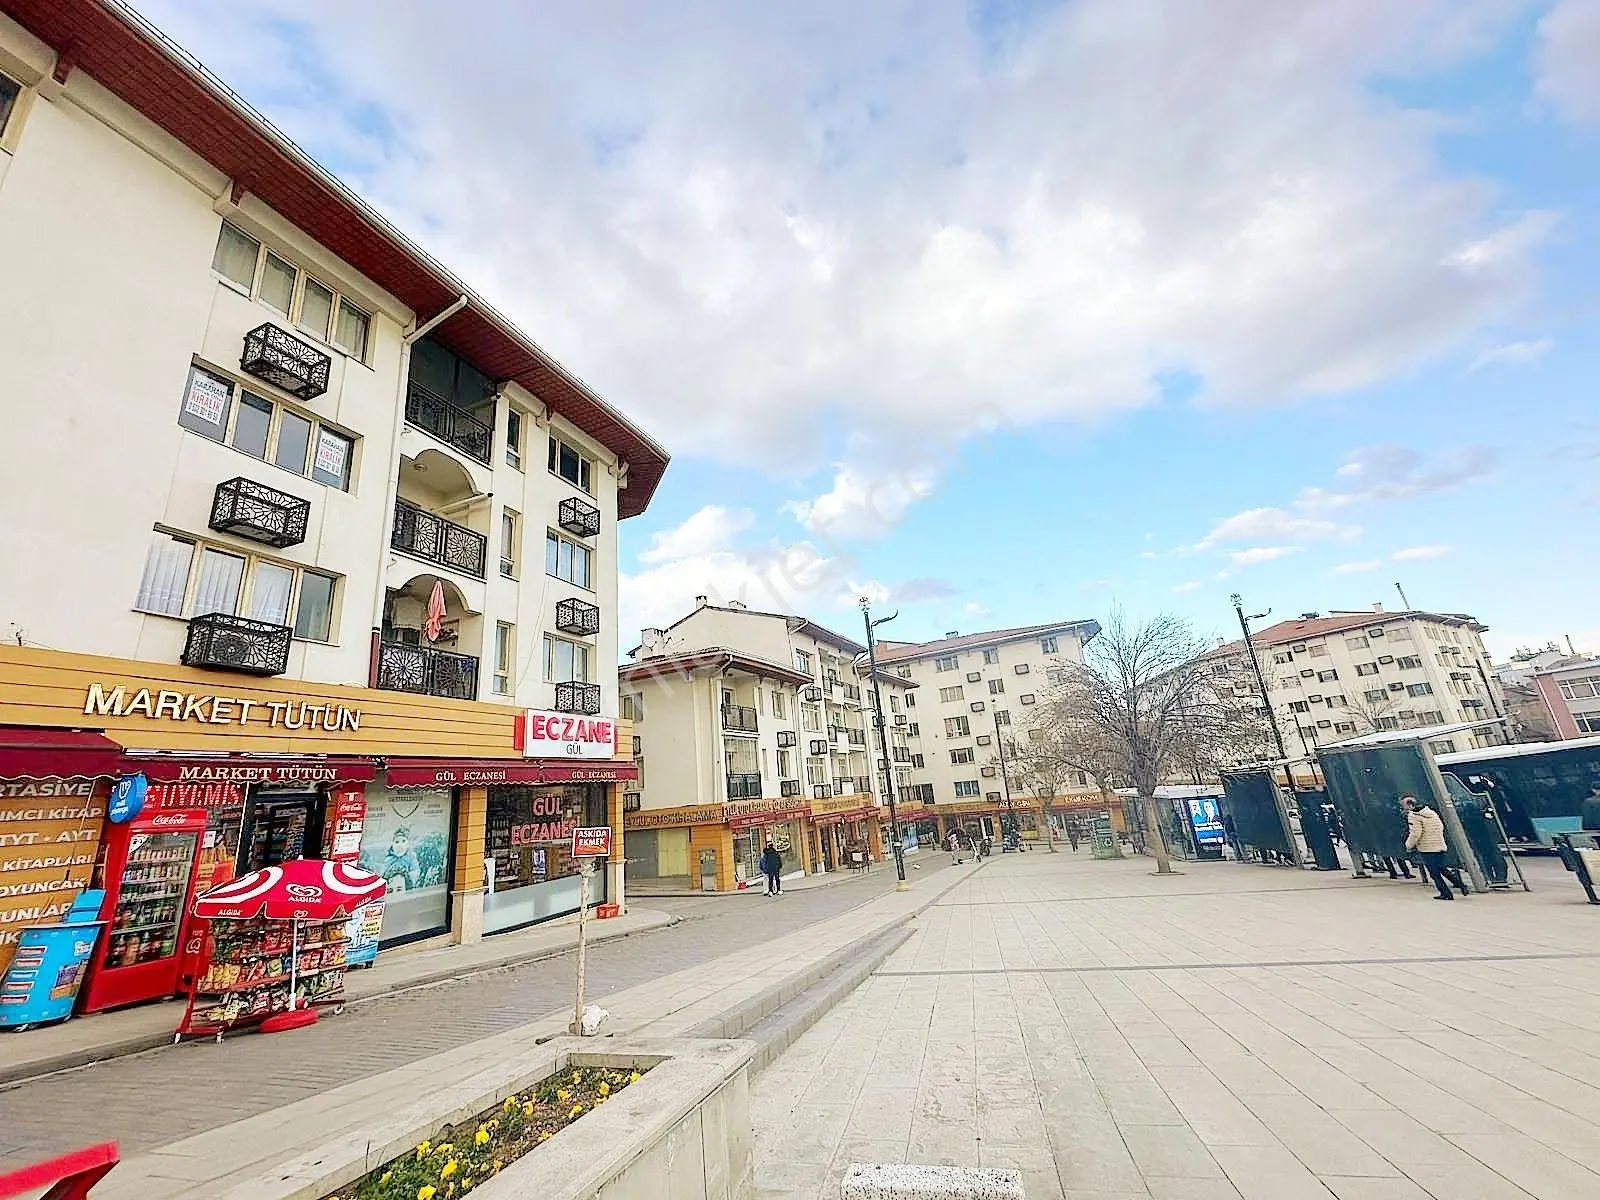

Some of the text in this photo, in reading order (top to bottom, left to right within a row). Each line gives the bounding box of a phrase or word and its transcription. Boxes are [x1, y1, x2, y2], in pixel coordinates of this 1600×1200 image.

[84, 683, 258, 725] MARKET
[532, 714, 612, 744] ECZANE
[566, 742, 584, 755] GÜL
[179, 764, 338, 780] MARKET TÜTÜN
[435, 769, 507, 781] GÜL ECZANESİ
[571, 769, 586, 779] GÜL
[48, 806, 102, 819] KİTAP
[56, 828, 97, 842] AYT
[577, 830, 607, 838] ASKIDA
[579, 838, 606, 846] EKMEK
[3, 854, 92, 872] KİTAPLARI
